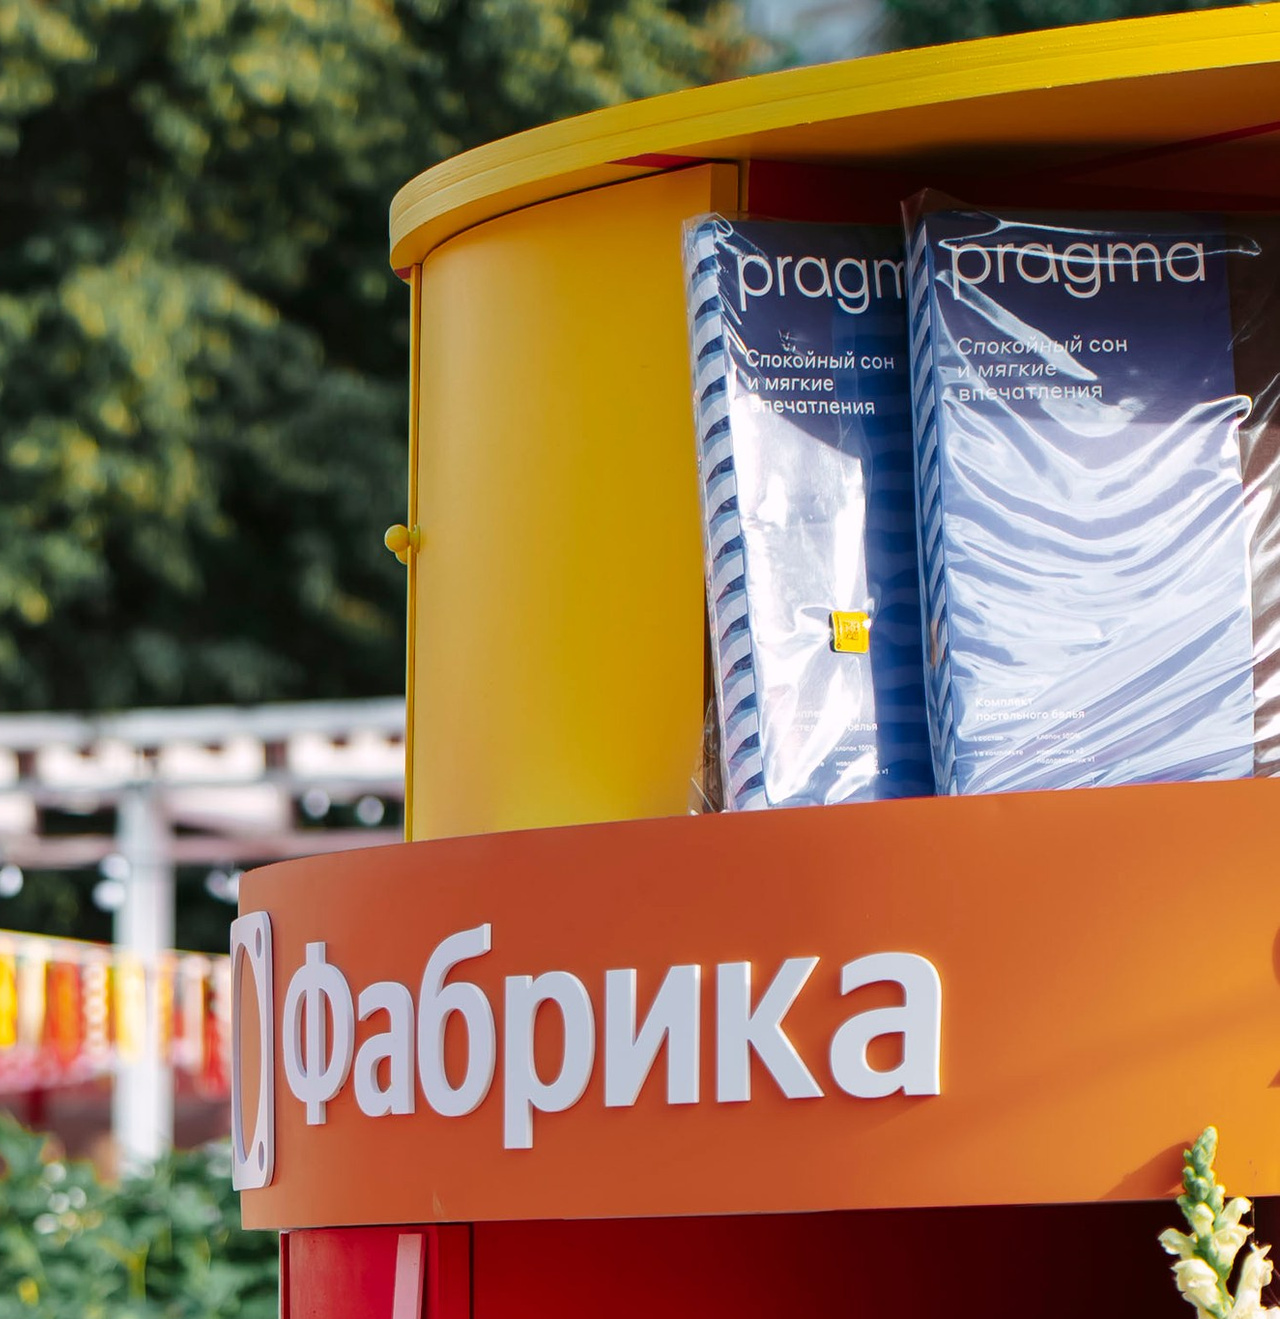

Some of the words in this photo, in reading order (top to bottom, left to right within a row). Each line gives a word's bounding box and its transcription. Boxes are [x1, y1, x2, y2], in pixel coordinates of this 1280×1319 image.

[951, 242, 1205, 300] pragma
[736, 254, 905, 315] pragm
[957, 335, 1082, 356] Спокойный
[1089, 338, 1128, 353] сон
[746, 348, 855, 370] Спокойный
[860, 355, 895, 370] сон
[957, 366, 970, 379] и
[977, 363, 1058, 378] мягкие
[747, 378, 760, 391] и
[765, 377, 834, 392] мягкие
[958, 383, 1103, 402] впечатления
[282, 922, 944, 1150] Фабрика
